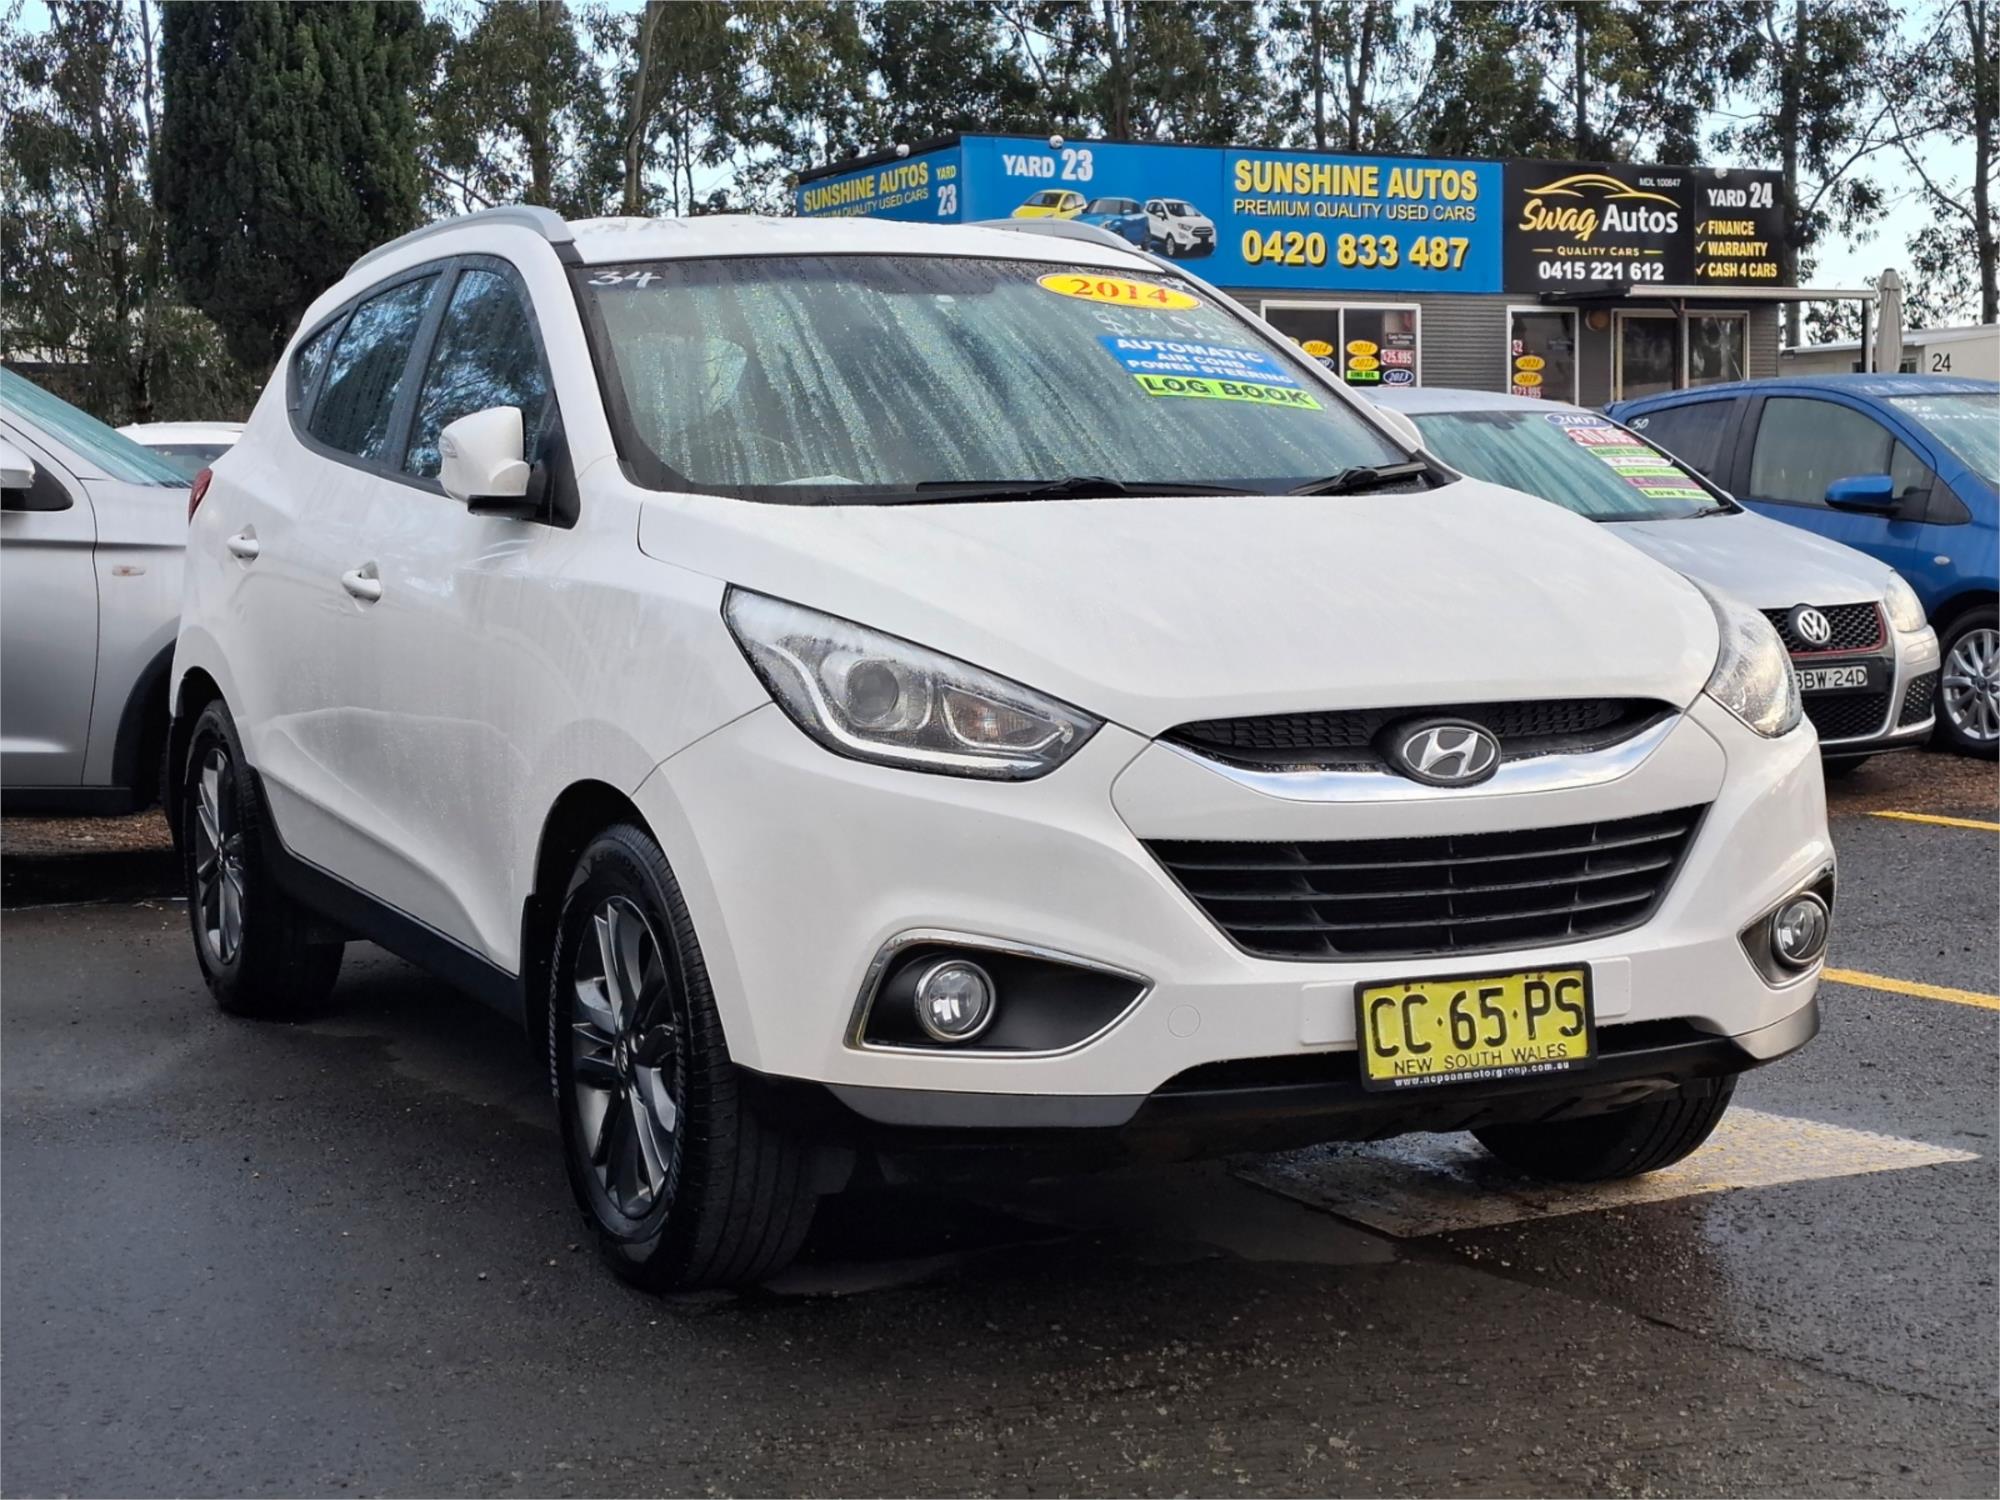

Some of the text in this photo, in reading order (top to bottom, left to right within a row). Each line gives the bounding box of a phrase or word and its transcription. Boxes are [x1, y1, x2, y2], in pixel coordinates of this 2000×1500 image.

[936, 165, 957, 180] YARD
[1002, 149, 1094, 181] YARD 23
[803, 162, 928, 212] SUNSHINE AUTOS
[1235, 159, 1478, 201] SUNSHINE AUTOS
[880, 194, 903, 209] USED
[904, 188, 928, 204] CARS
[937, 184, 957, 216] 23
[1707, 182, 1774, 209] YARD 24
[1234, 198, 1476, 222] PREMIUM QUALITY USED CARS
[1519, 198, 1679, 242] Swag Autos
[1708, 220, 1755, 236] FINANCE
[1242, 229, 1469, 268] 0420 833 487
[1557, 246, 1640, 257] QUALITY CARS
[1708, 241, 1768, 257] WARRANTY
[588, 271, 662, 288] 34
[1539, 261, 1664, 281] 0415 221 612
[1708, 263, 1778, 278] CASH 4 CARS
[1071, 279, 1170, 303] 2014
[1117, 338, 1265, 364] AUTOMATIC
[1158, 353, 1252, 370] AIR COND.
[1932, 353, 1952, 372] 24
[1127, 360, 1294, 384] POWER STEERING
[1144, 376, 1311, 406] LOG BOOK
[1632, 418, 1650, 430] 50
[1394, 1043, 1567, 1076] NEW SOUTH WALES
